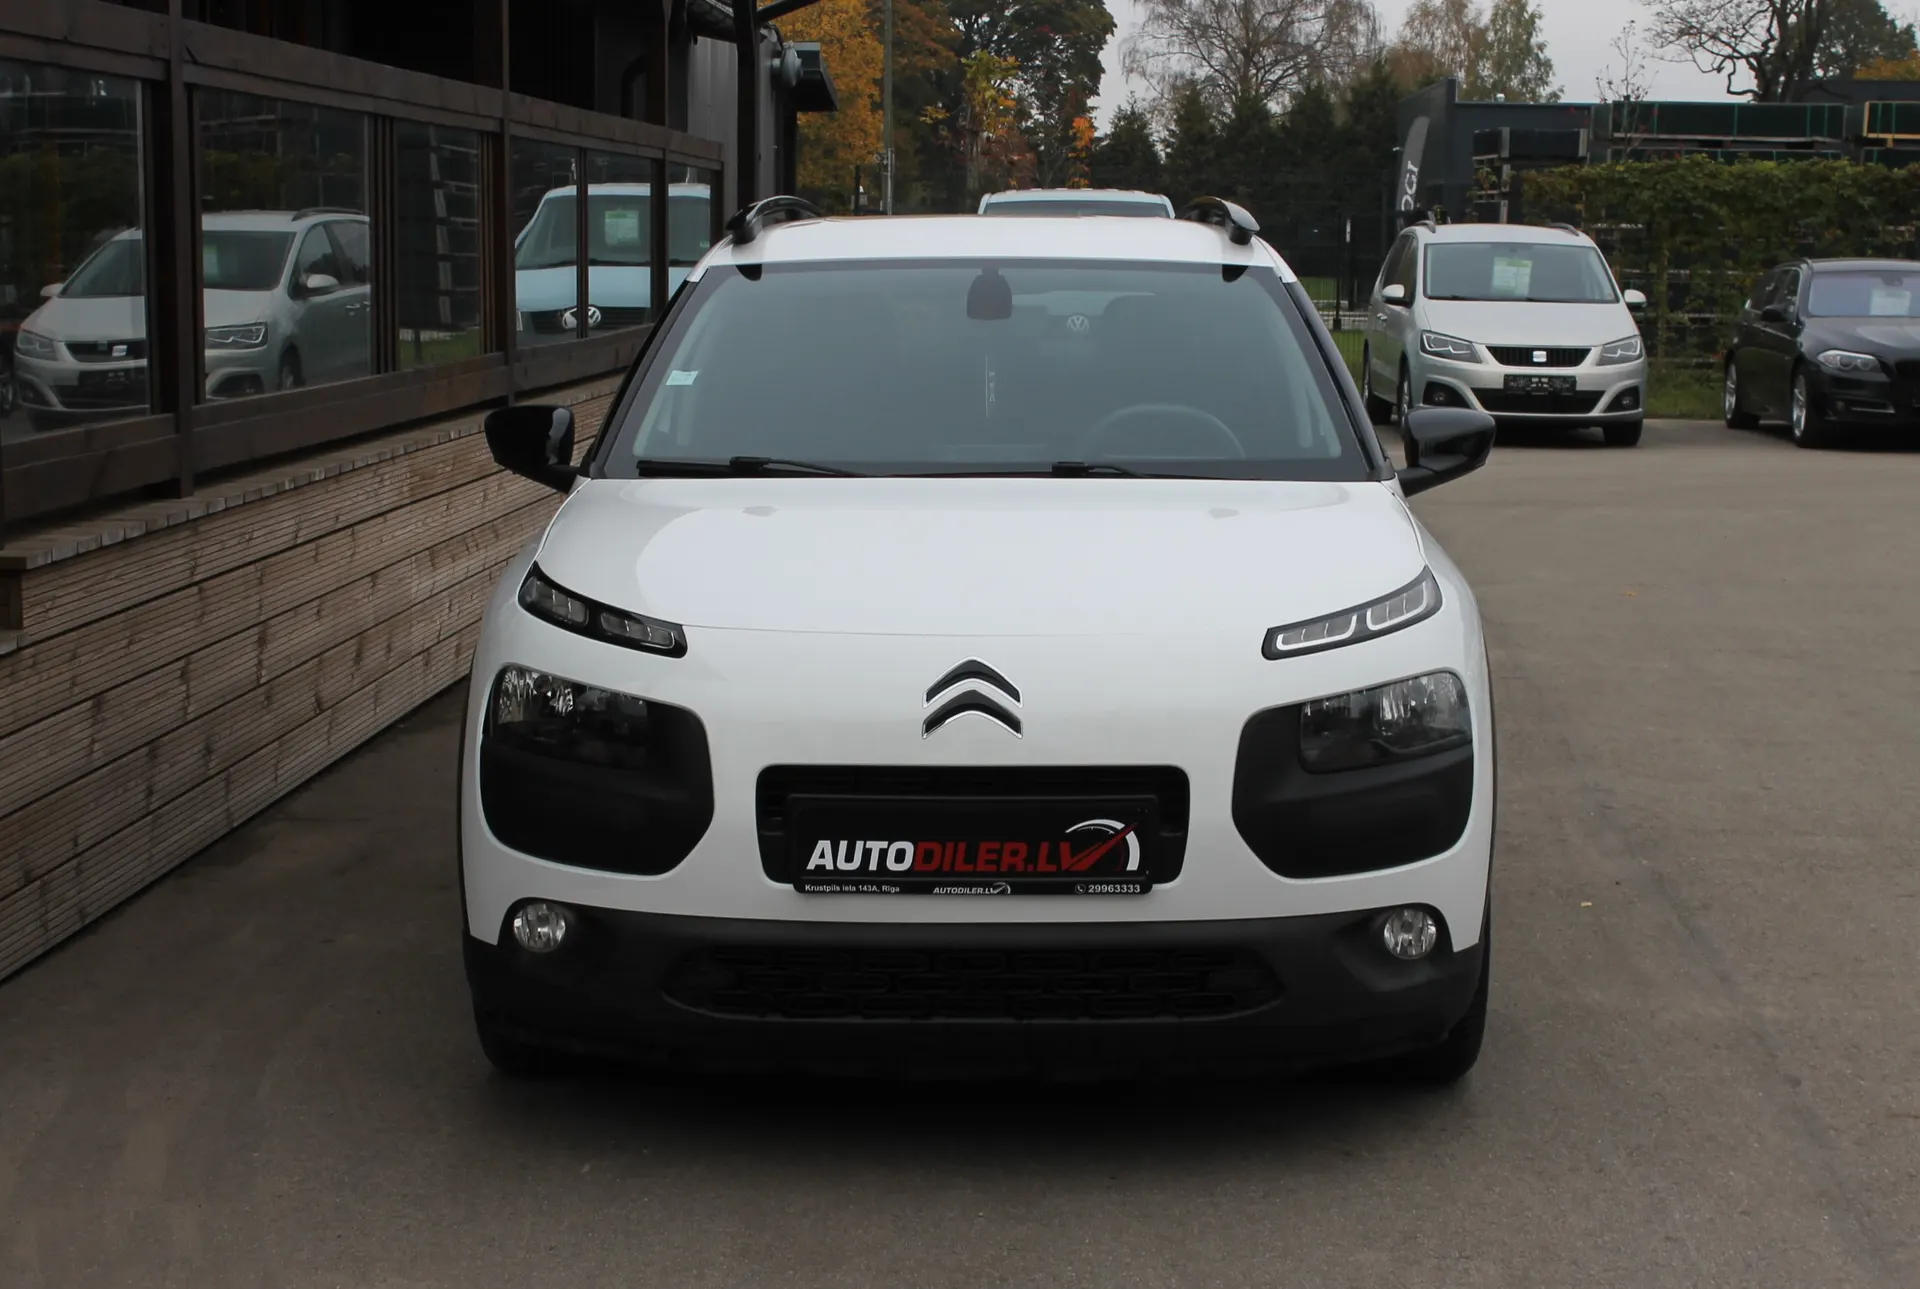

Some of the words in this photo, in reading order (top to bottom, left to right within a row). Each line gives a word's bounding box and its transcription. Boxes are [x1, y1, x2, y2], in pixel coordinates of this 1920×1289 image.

[805, 826, 1136, 872] AUTODILER.LV
[804, 884, 841, 894] Krustpils
[842, 884, 857, 893] iela
[1088, 884, 1141, 893] 29963333
